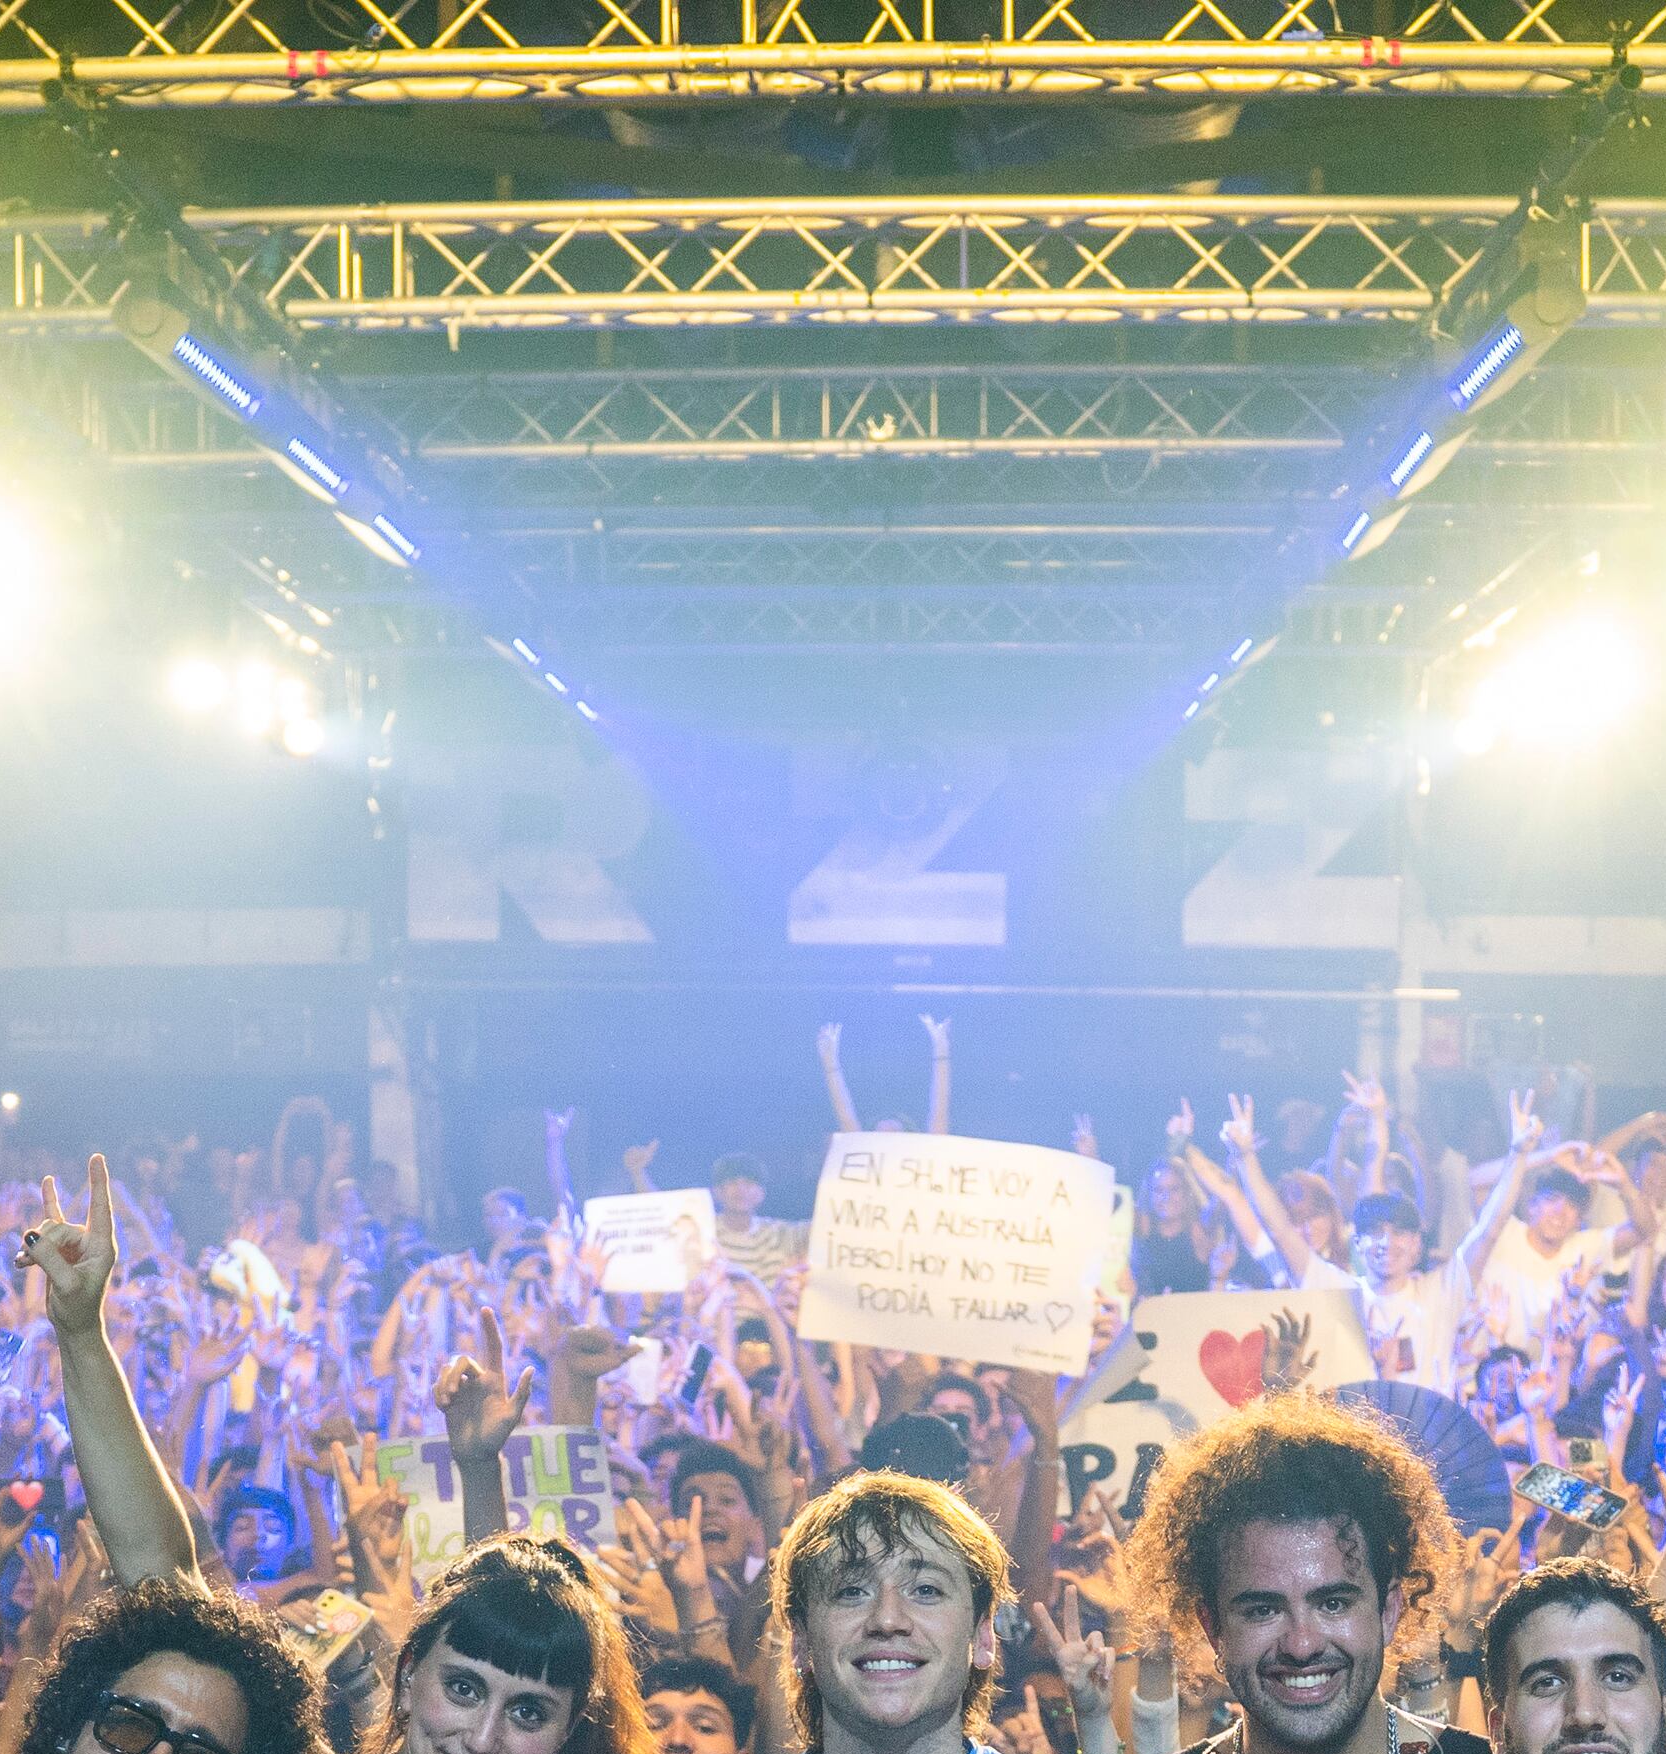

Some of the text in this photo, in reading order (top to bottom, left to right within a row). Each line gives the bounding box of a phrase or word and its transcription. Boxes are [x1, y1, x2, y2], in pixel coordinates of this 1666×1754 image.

[839, 1151, 884, 1187] EN
[948, 1165, 979, 1195] ME
[989, 1167, 1031, 1198] VOY
[1050, 1179, 1072, 1206] A
[902, 1209, 920, 1234] A
[909, 1252, 947, 1277] HOY
[959, 1258, 994, 1282] NO
[1005, 1261, 1050, 1287] TE
[420, 1432, 606, 1503] TTUE
